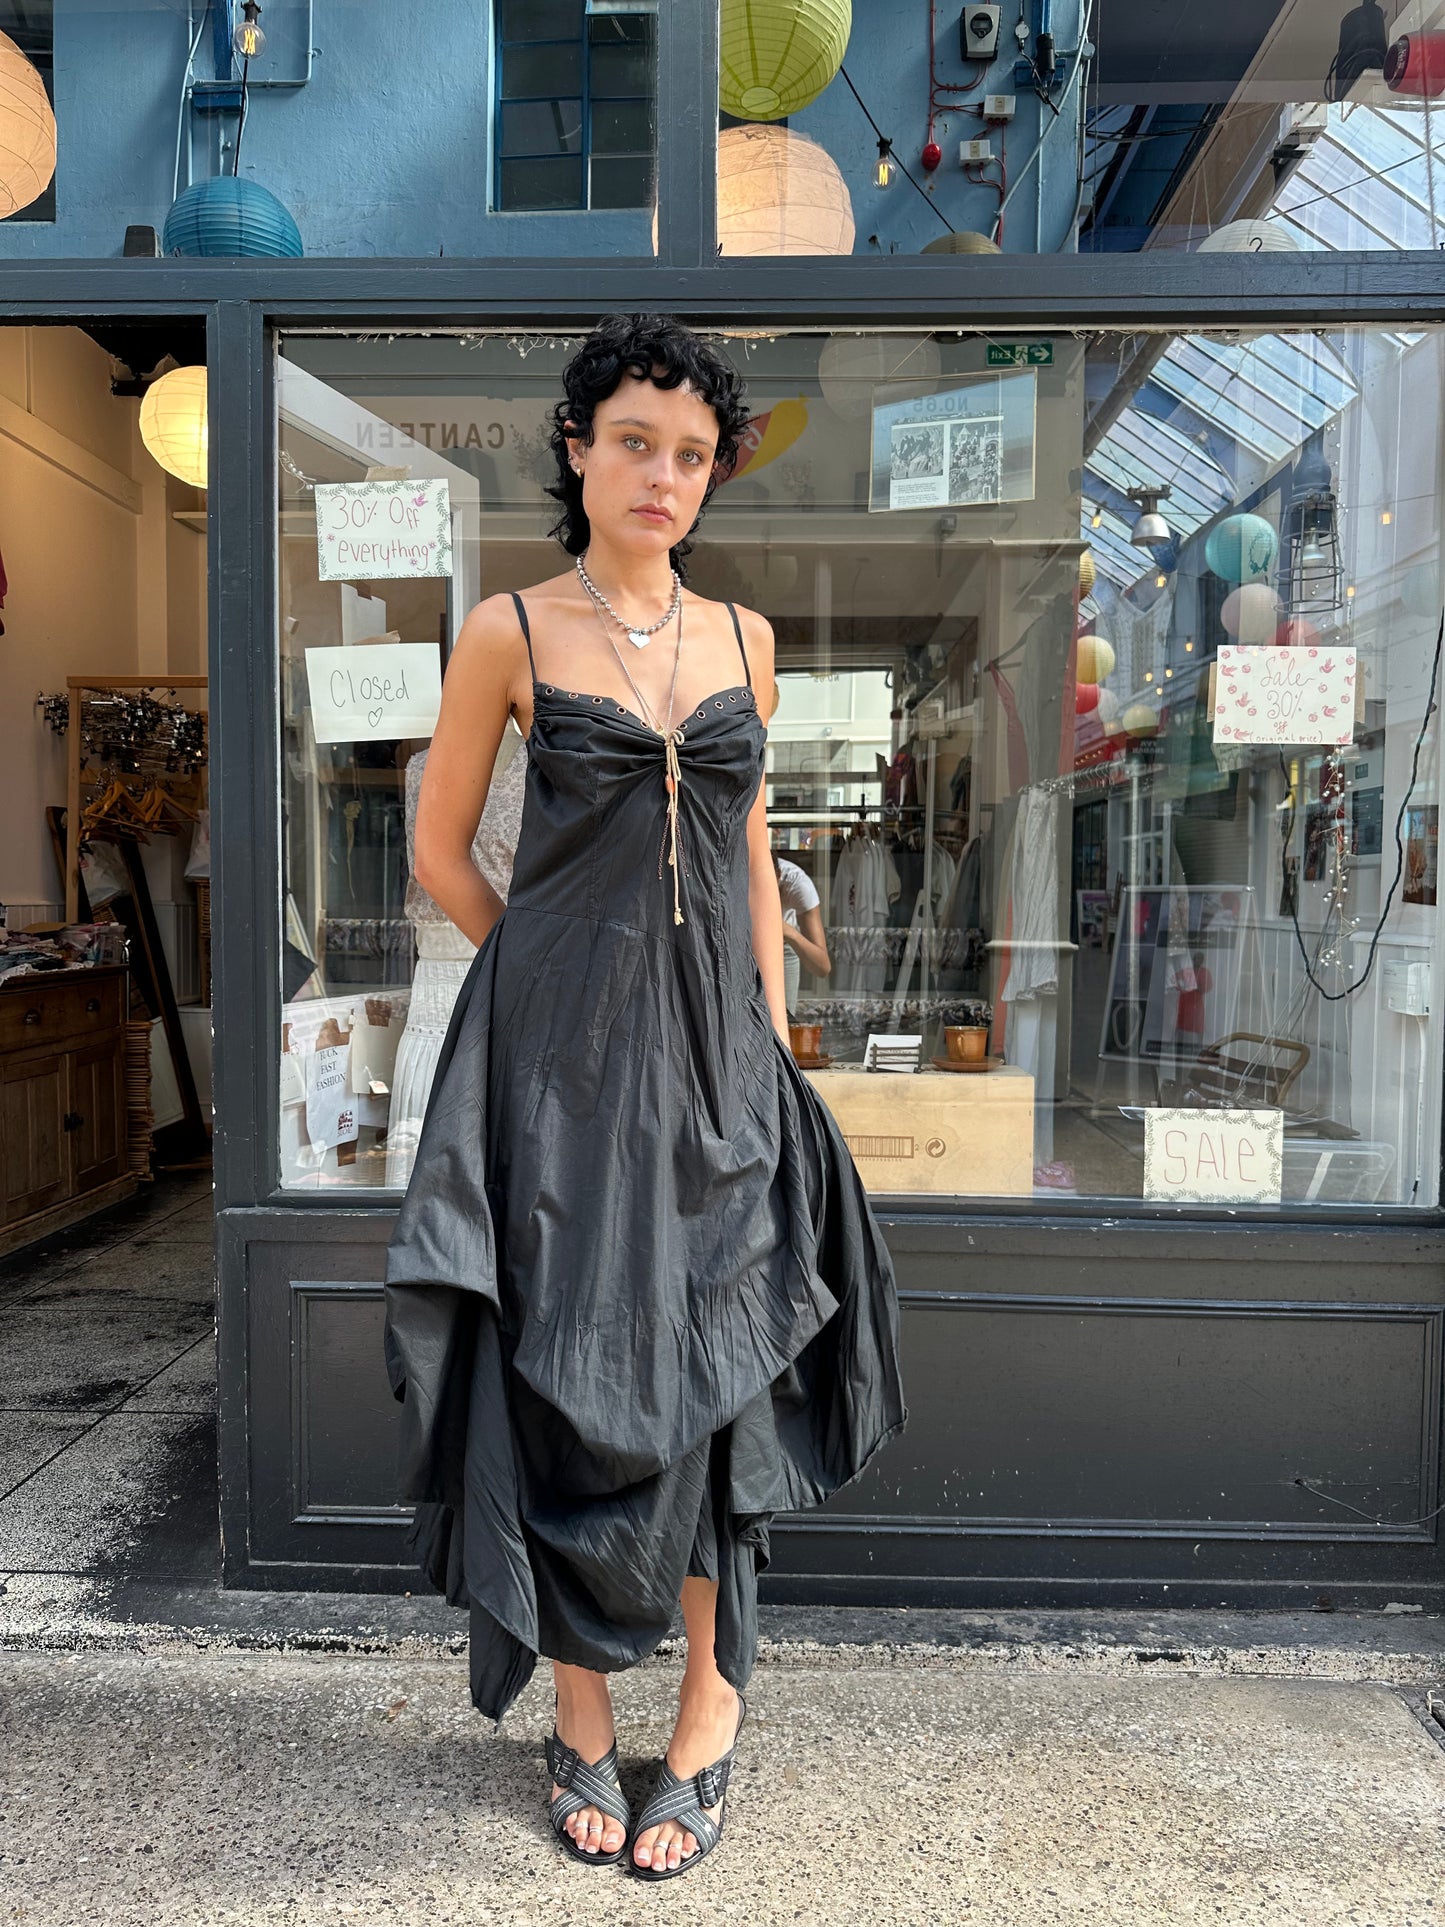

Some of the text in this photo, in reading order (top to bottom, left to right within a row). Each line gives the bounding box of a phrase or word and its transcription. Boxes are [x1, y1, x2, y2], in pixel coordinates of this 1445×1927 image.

[330, 495, 420, 530] 30% Off
[338, 539, 428, 571] everything
[1260, 655, 1315, 687] Sale
[331, 668, 410, 708] Closed
[1266, 690, 1303, 719] 30%
[1273, 721, 1289, 734] off
[316, 1072, 347, 1092] FASHION
[320, 1061, 337, 1075] FAST
